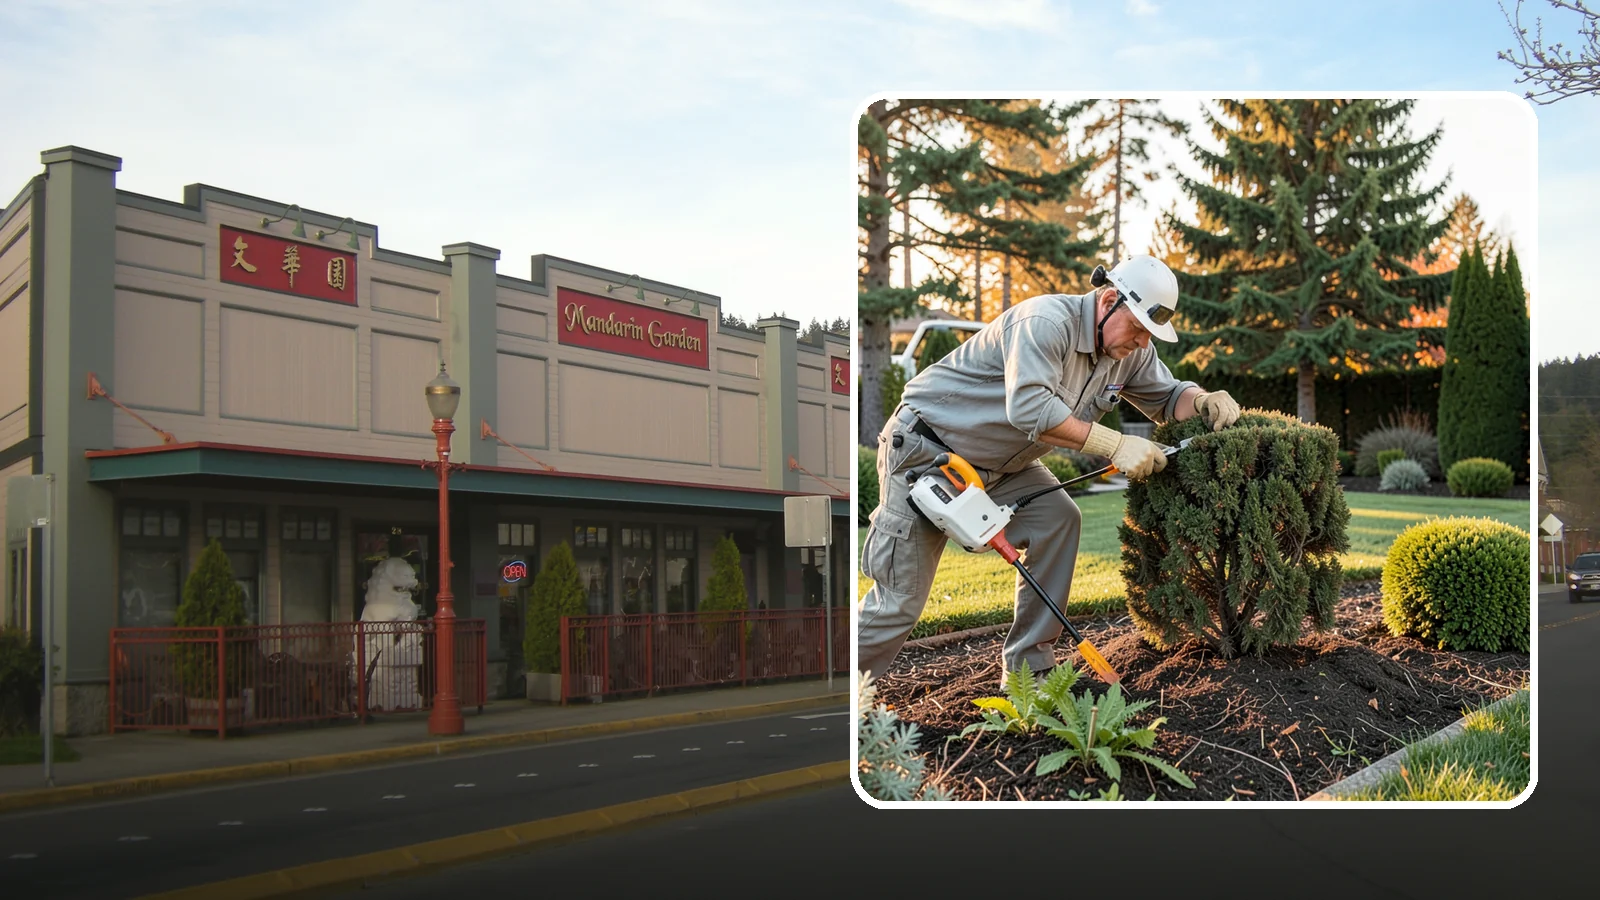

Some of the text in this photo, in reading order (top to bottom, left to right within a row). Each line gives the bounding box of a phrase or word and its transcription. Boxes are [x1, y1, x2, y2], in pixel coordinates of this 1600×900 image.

[230, 235, 347, 292] 文華園
[564, 302, 702, 352] Mandarin Garden
[503, 565, 526, 578] OPEN
